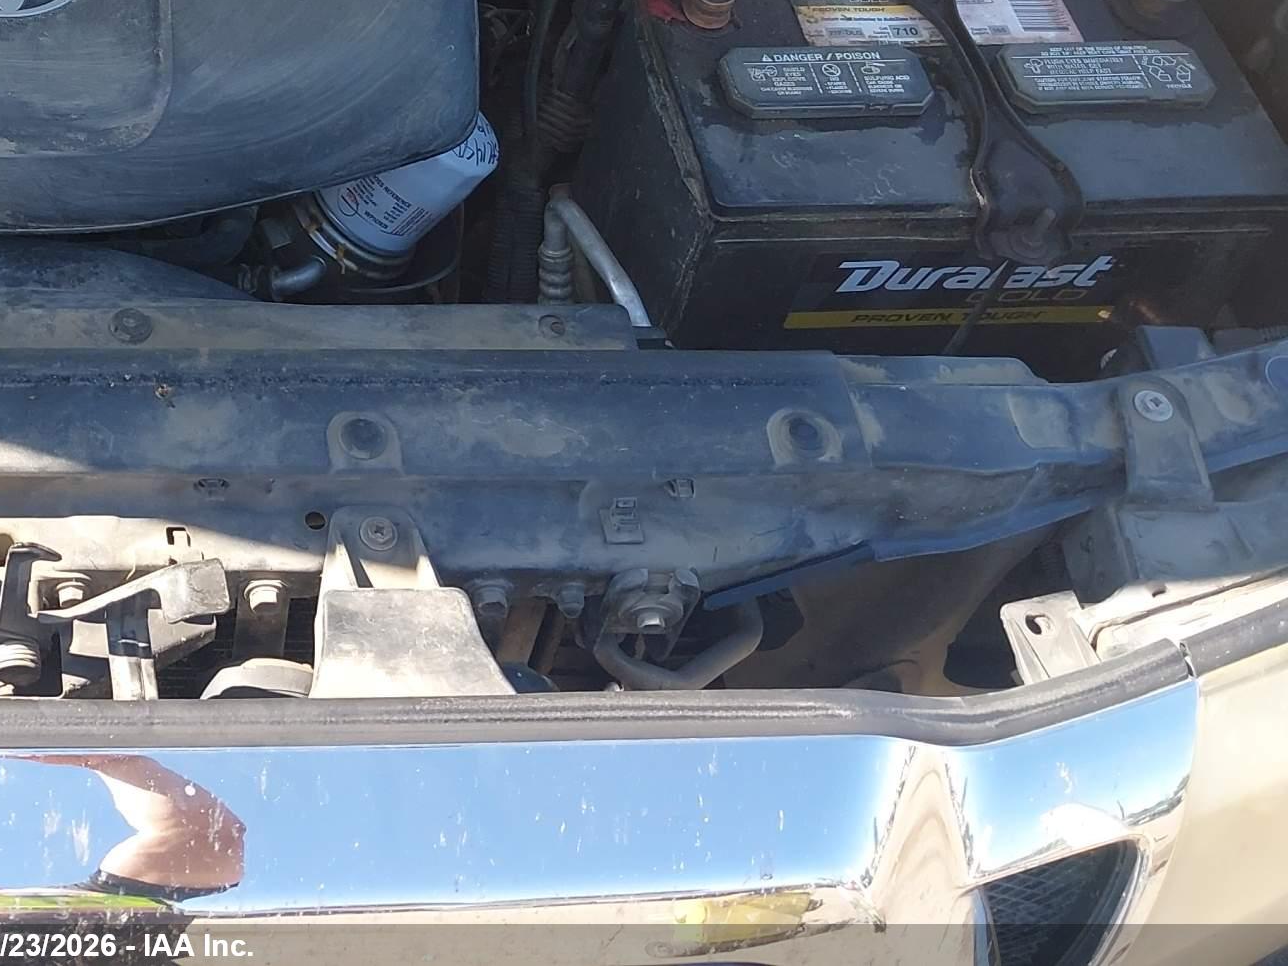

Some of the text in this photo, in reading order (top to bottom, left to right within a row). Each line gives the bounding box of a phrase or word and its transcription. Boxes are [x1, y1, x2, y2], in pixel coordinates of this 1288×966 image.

[893, 27, 919, 36] 710
[773, 53, 824, 62] DANGER
[834, 52, 881, 60] POISON
[851, 312, 953, 324] PROVEN
